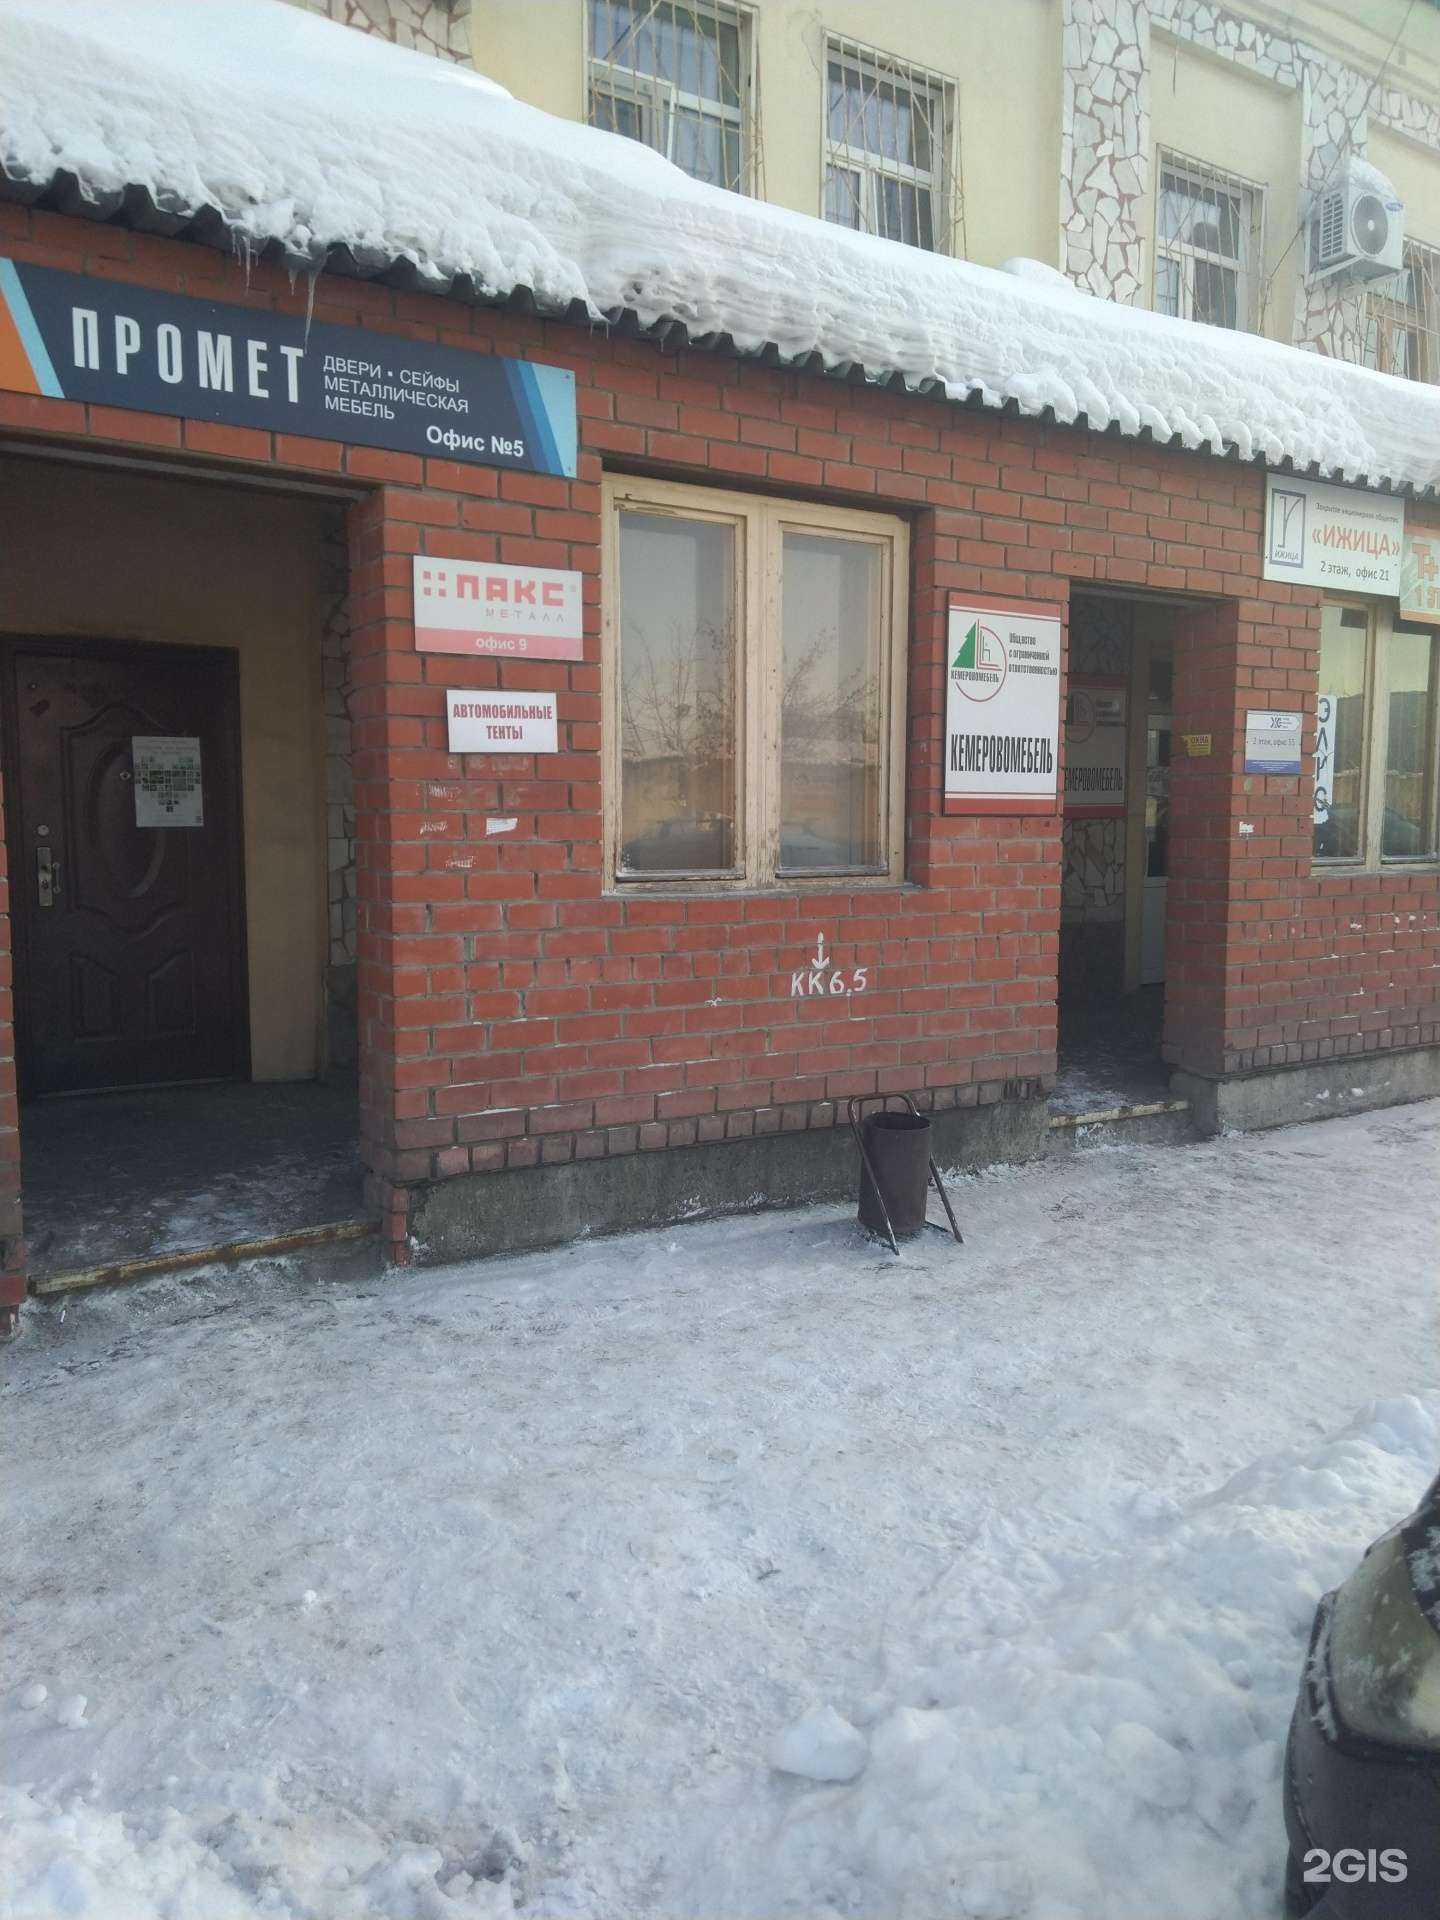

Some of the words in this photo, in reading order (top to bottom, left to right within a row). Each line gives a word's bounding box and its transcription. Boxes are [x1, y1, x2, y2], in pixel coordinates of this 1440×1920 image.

[72, 306, 305, 404] ПРОМЕТ
[323, 354, 382, 379] ДВЕРИ
[400, 369, 460, 393] СЕЙФЫ
[324, 375, 469, 413] МЕТАЛЛИЧЕСКАЯ
[325, 394, 396, 420] МЕБЕЛЬ
[426, 425, 486, 451] Офис
[491, 435, 525, 458] №5
[1312, 523, 1401, 560] «ИЖИЦА»
[1274, 550, 1299, 561] ИЖИЦА
[1320, 560, 1327, 572] 2
[1327, 563, 1351, 577] этаж,
[1355, 566, 1378, 581] офис
[1379, 568, 1389, 581] 21
[456, 573, 564, 608] ПАКС
[475, 636, 516, 653] офис
[519, 639, 529, 650] 9
[1008, 632, 1036, 646] Общество
[951, 670, 1000, 683] КЕМЕРОВОМЕБЕЛЬ
[453, 703, 553, 720] АВТОМОБИЛЬНЫЕ
[486, 725, 523, 740] ТЕНТЫ
[950, 733, 1053, 774] КЕМЕРОВОМЕБЕЛЬ
